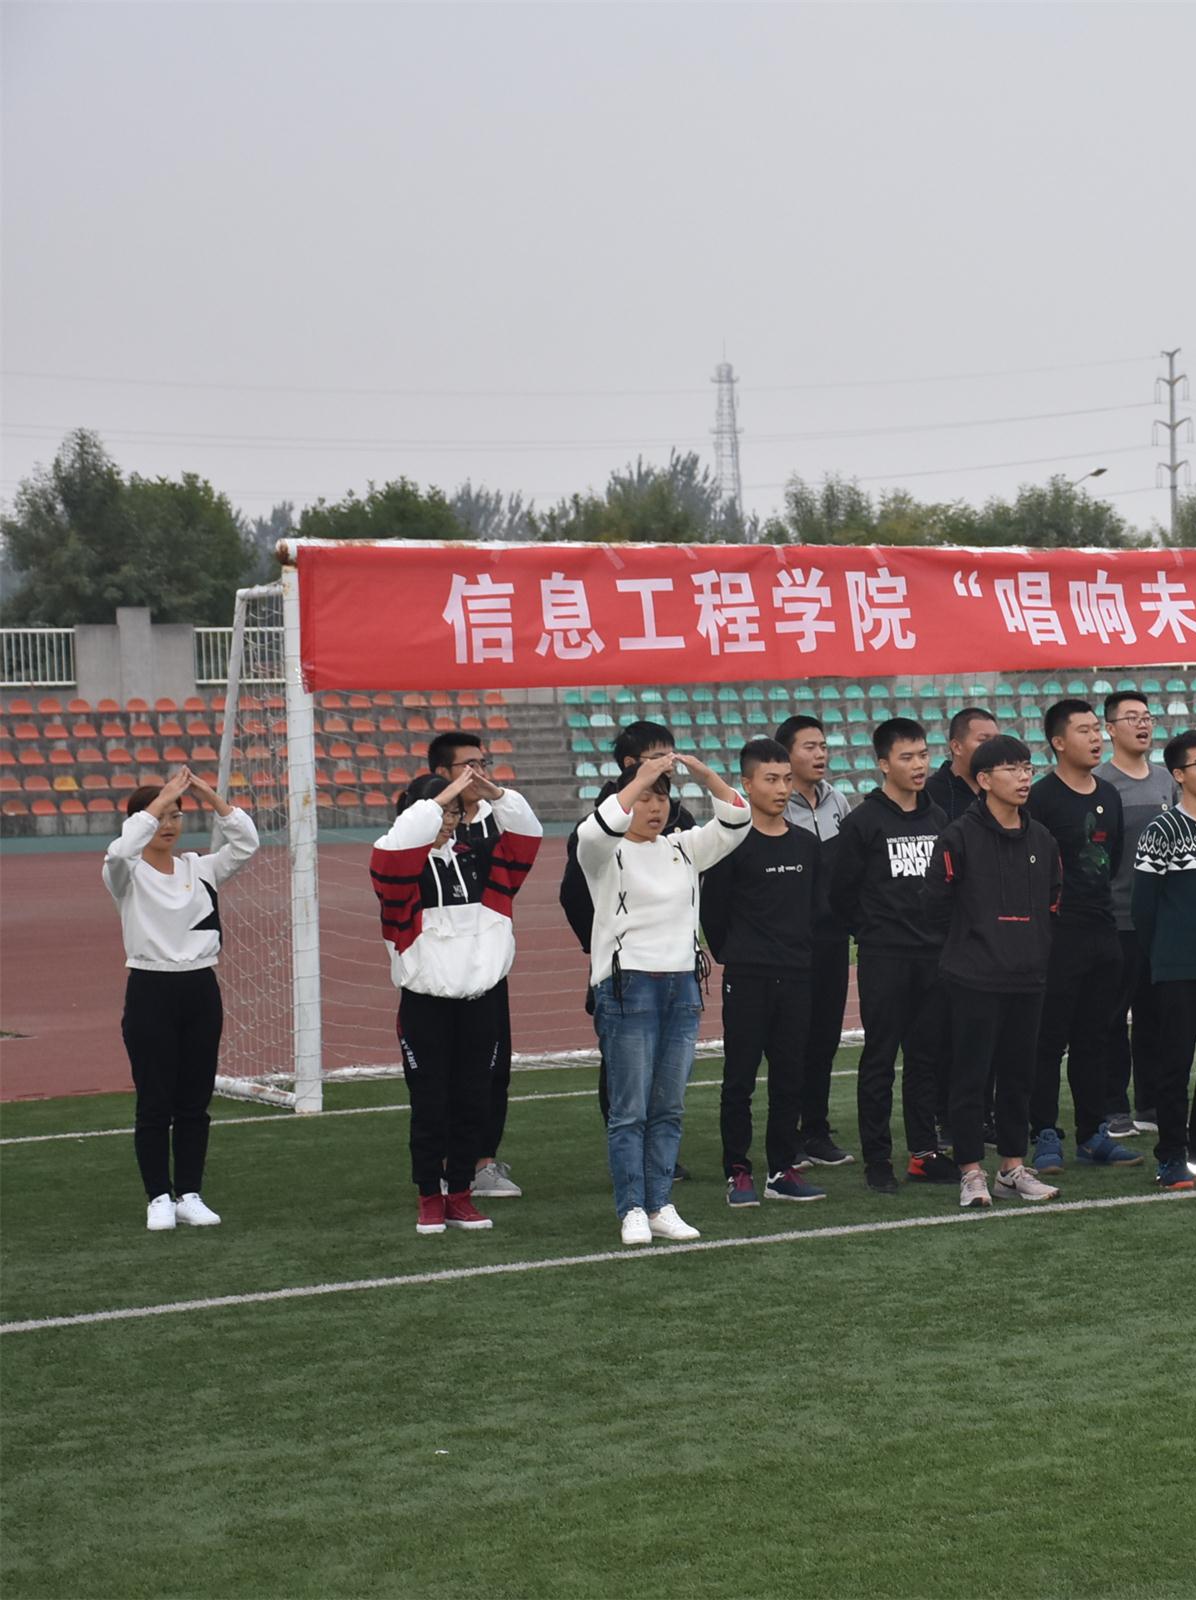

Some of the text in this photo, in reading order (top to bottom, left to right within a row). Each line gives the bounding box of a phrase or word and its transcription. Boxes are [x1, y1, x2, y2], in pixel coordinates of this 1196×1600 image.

[442, 567, 917, 664] 信息工程学院
